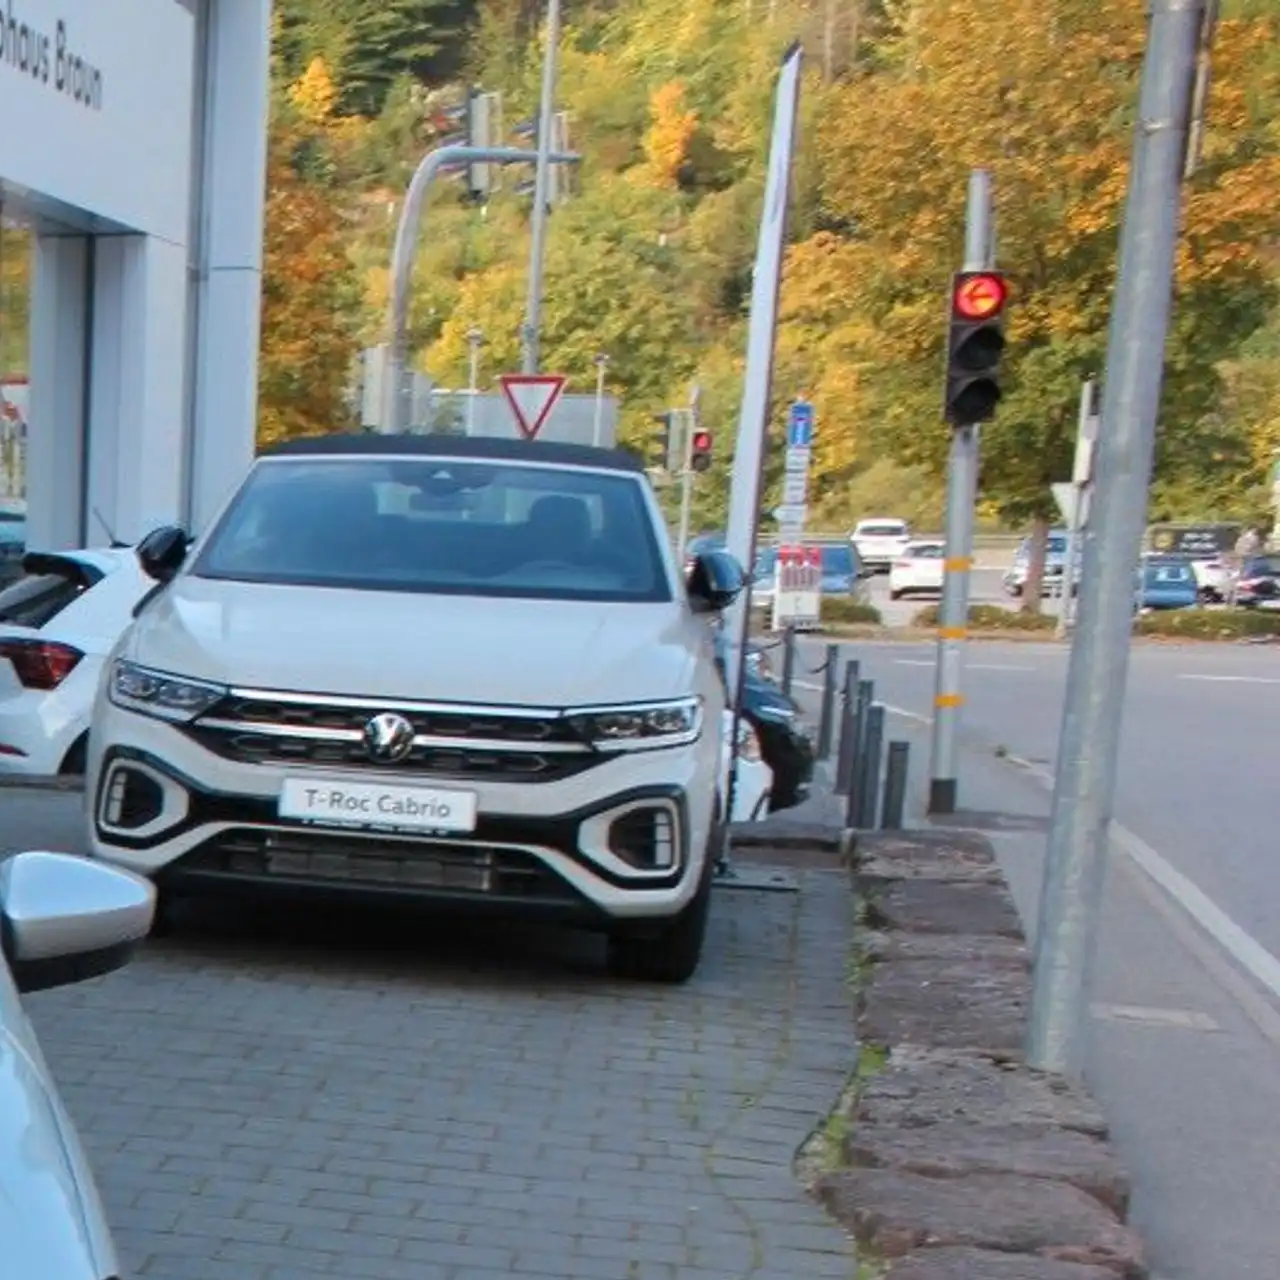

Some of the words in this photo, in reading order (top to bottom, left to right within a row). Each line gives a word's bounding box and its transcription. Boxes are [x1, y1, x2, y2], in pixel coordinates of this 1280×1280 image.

[56, 19, 103, 111] Braun
[305, 788, 370, 812] T-Roc
[377, 794, 451, 818] Cabrio
